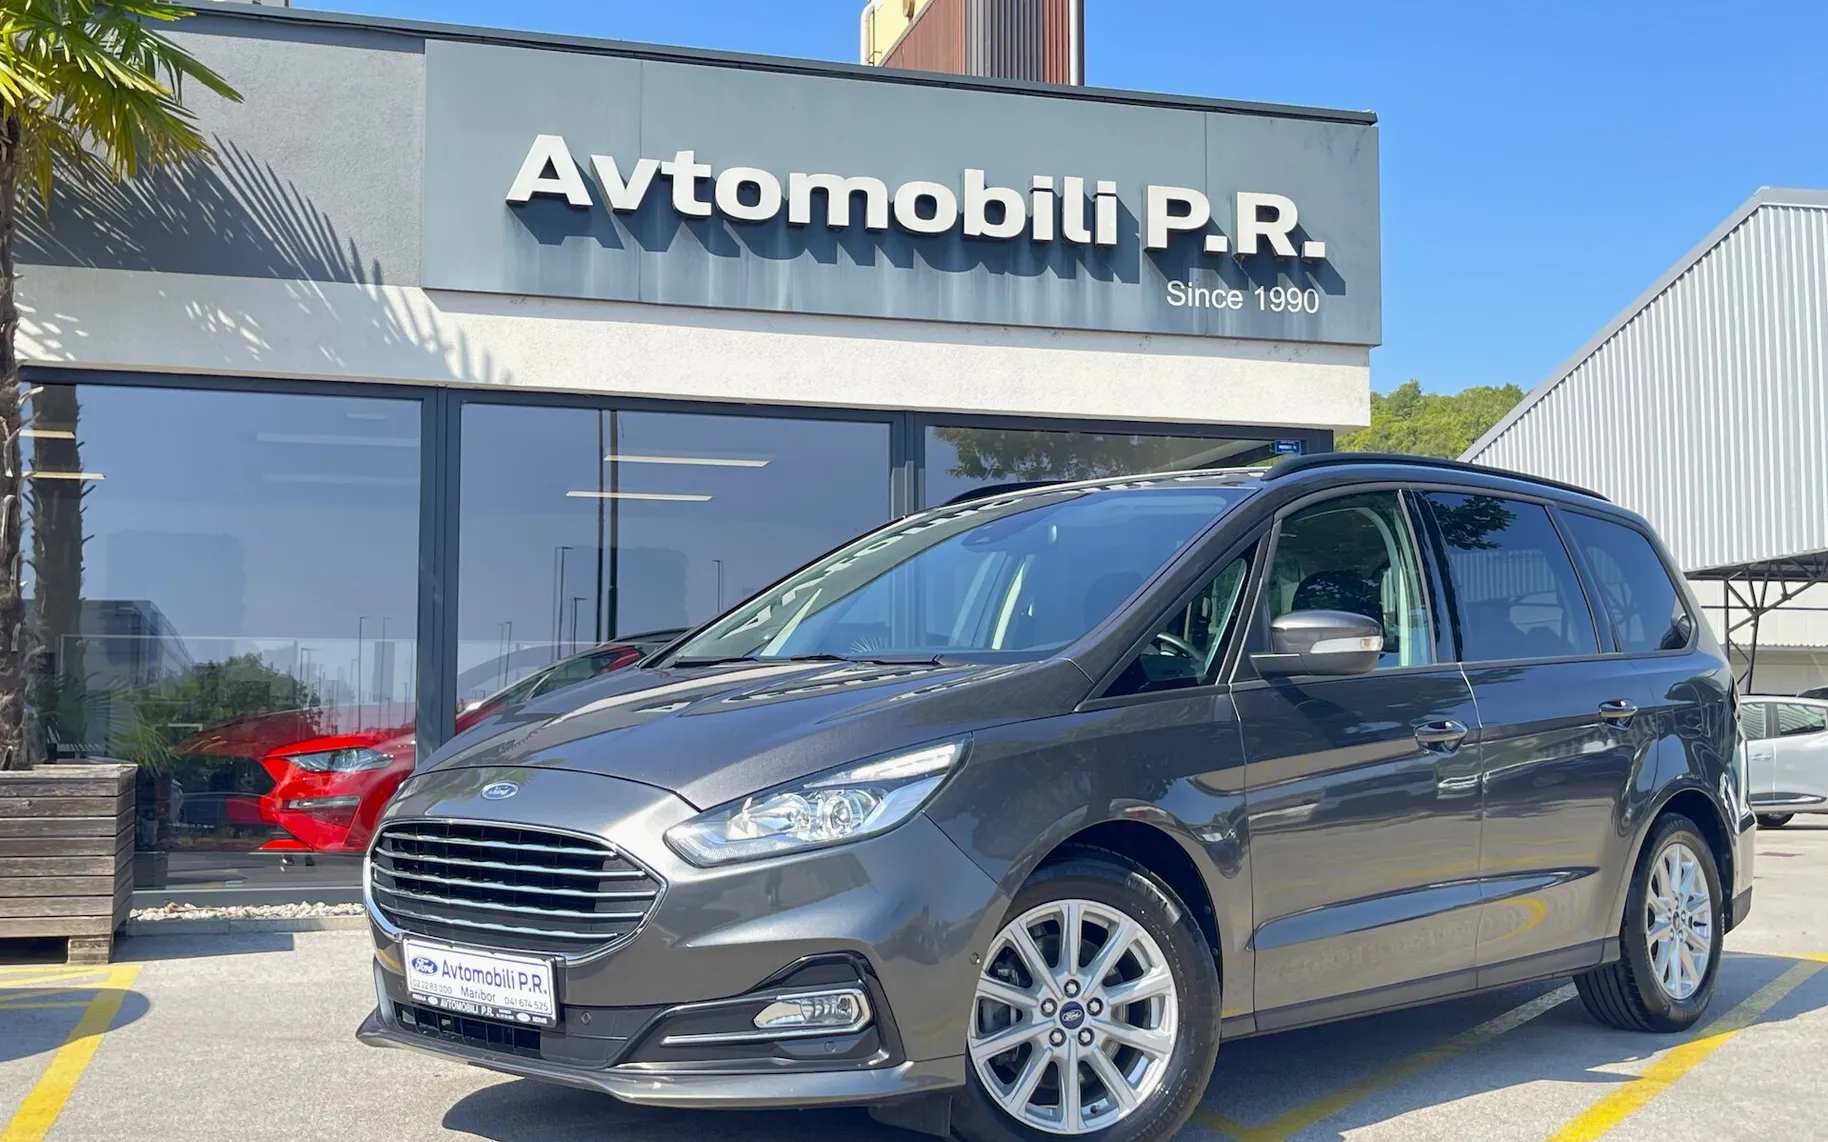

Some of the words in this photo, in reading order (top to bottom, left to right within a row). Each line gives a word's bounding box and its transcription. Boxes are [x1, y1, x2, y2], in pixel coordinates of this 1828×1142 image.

[505, 134, 1117, 245] Avtomobili
[1144, 185, 1326, 258] P.R.
[1166, 280, 1243, 309] Since
[1254, 285, 1319, 314] 1990
[486, 784, 514, 798] Ford
[413, 957, 436, 974] Ford
[442, 959, 515, 990] Avtomobili
[518, 971, 548, 995] P.R.
[461, 985, 496, 1002] Maribor
[440, 998, 479, 1014] AVTOMOBILI
[504, 996, 518, 1006] 041
[519, 998, 533, 1008] 674
[534, 1000, 549, 1011] 525
